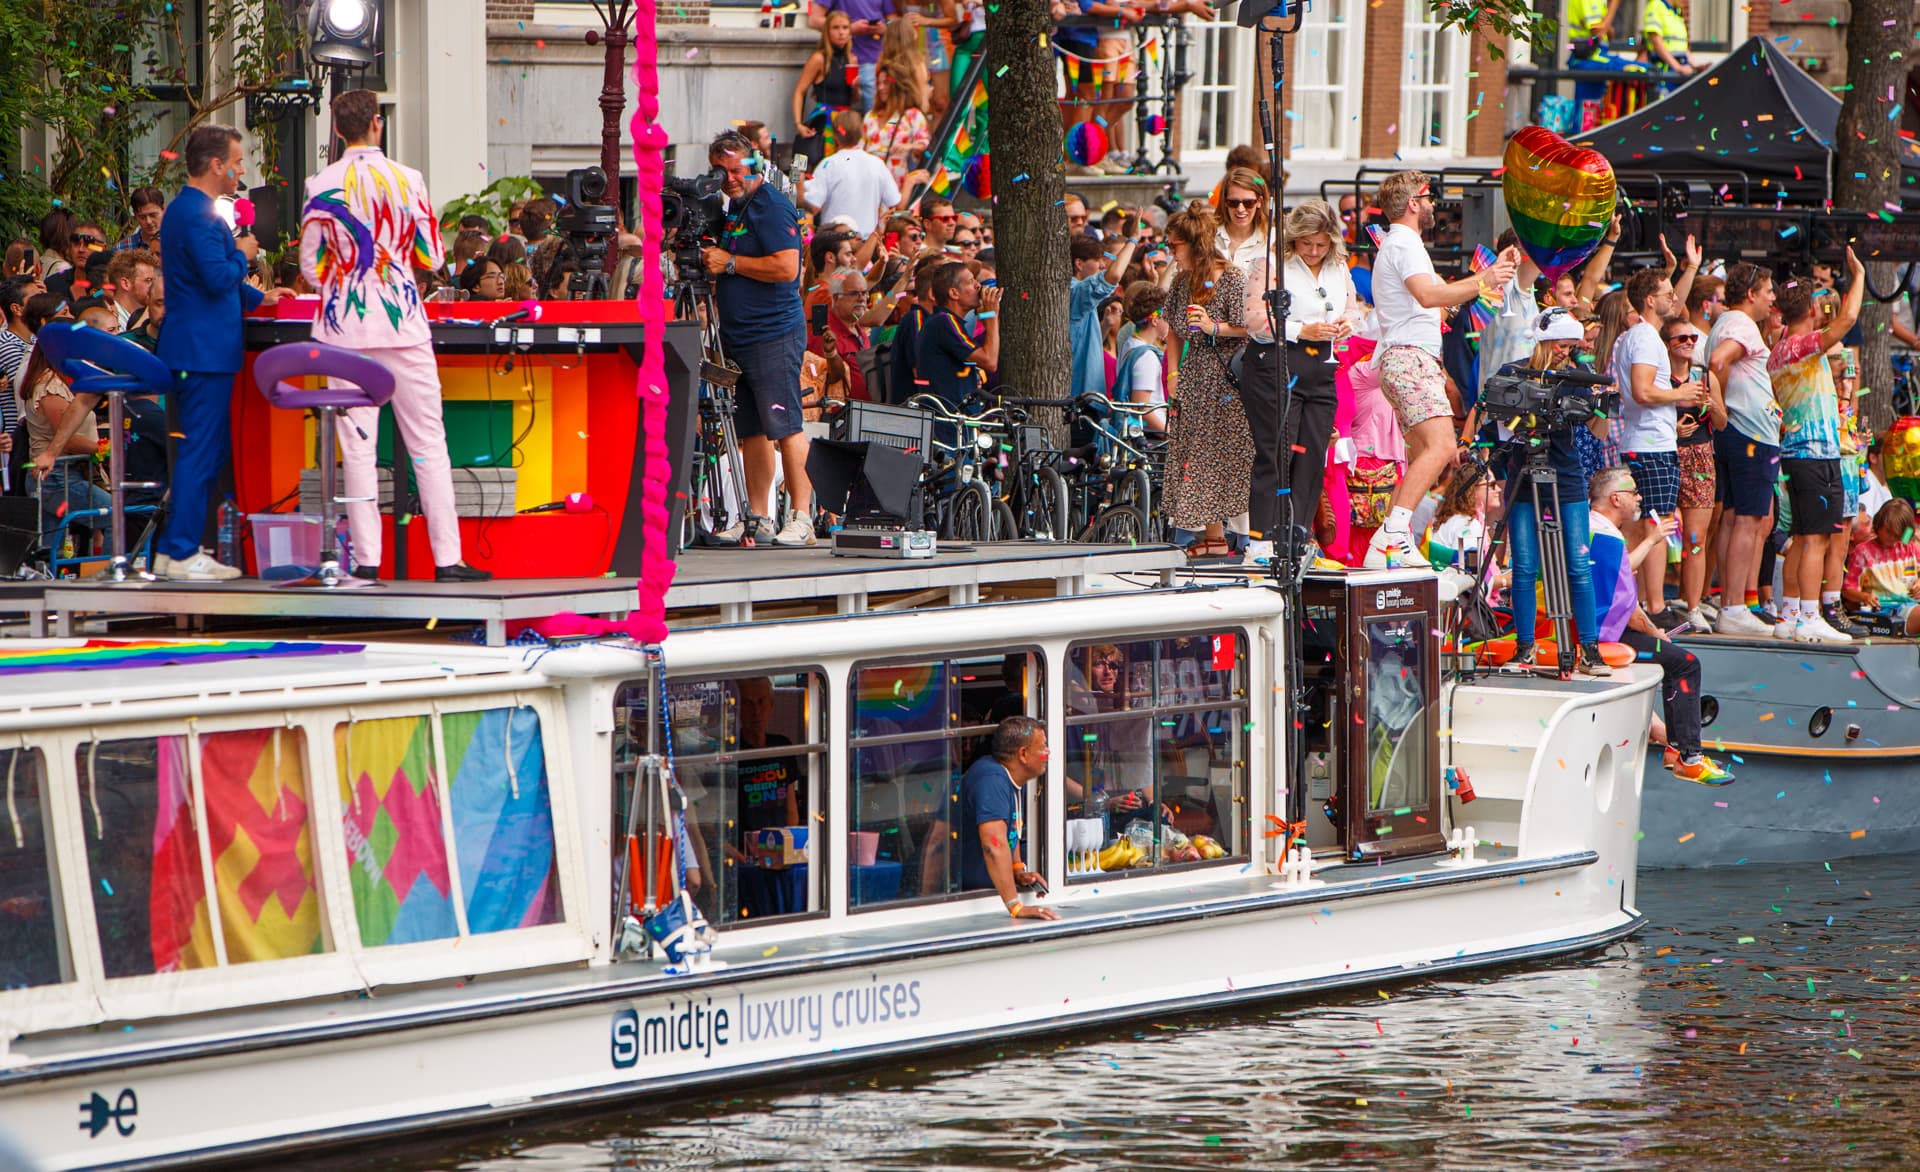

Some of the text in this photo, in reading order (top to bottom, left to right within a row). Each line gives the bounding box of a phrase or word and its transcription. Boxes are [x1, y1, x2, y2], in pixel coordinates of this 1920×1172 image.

[751, 768, 788, 784] JOU
[747, 786, 787, 805] ONS
[738, 993, 823, 1042] luxury
[831, 973, 922, 1029] cruises
